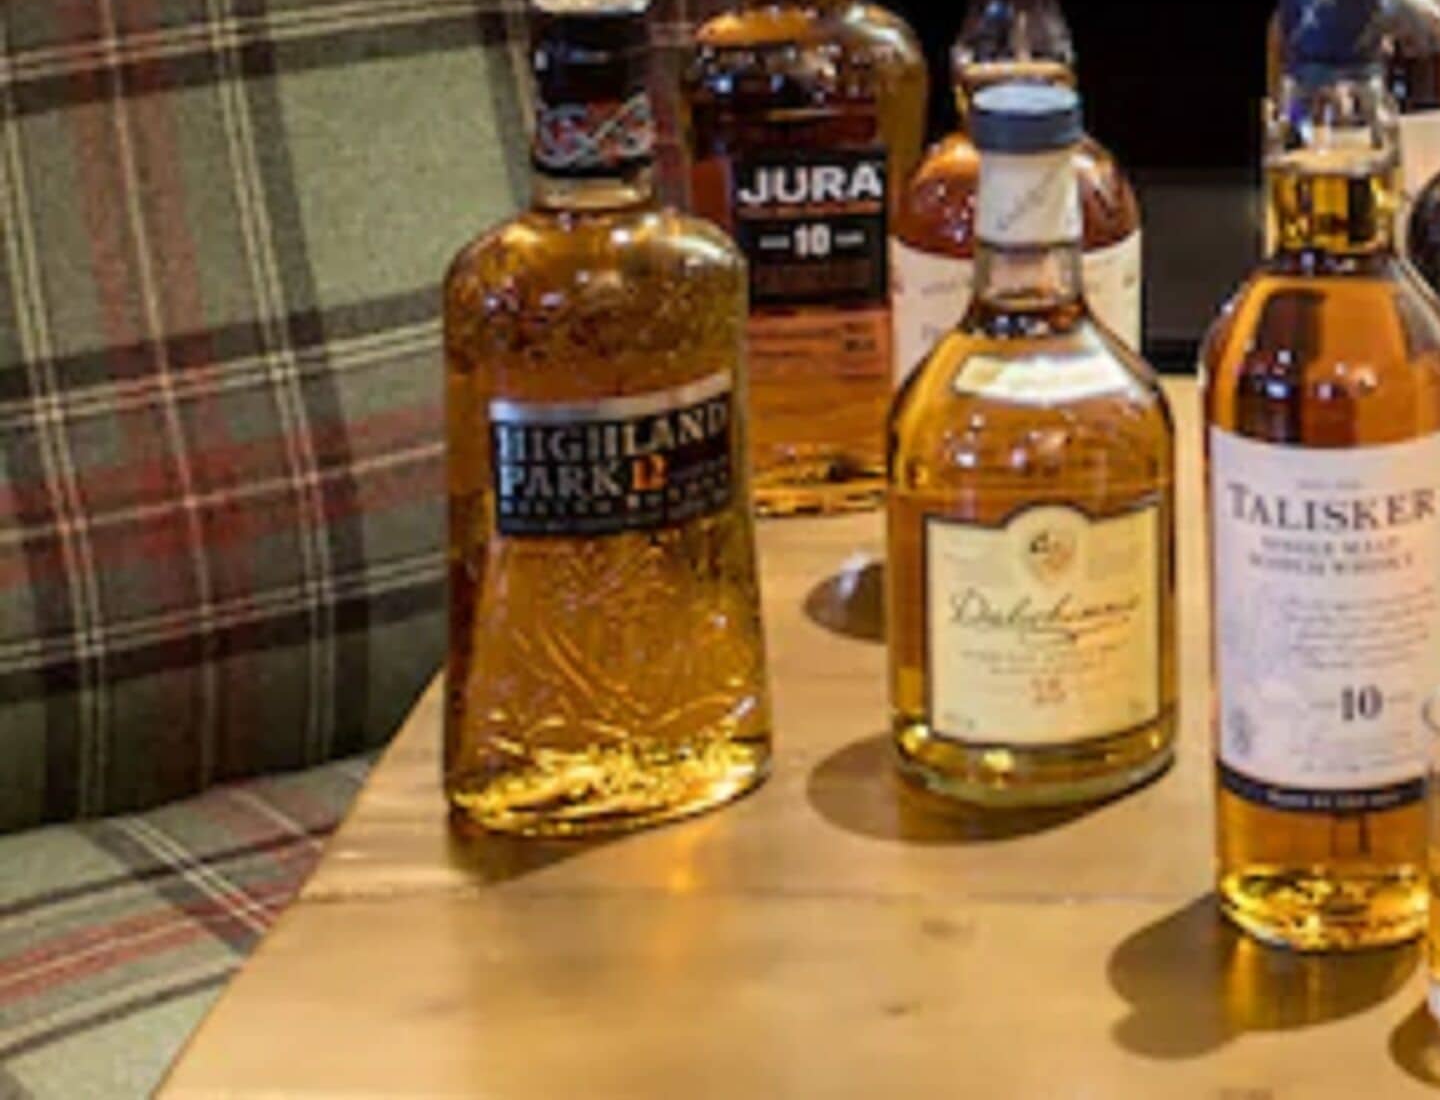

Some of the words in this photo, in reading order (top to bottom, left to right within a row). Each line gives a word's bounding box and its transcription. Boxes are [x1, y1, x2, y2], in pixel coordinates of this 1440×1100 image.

[738, 161, 883, 203] JURA
[793, 222, 830, 257] 10
[498, 400, 728, 462] HIGHLAND
[500, 456, 624, 500] PARK
[632, 453, 669, 492] 12
[1227, 481, 1436, 531] TALISKER
[1341, 685, 1383, 722] 10
